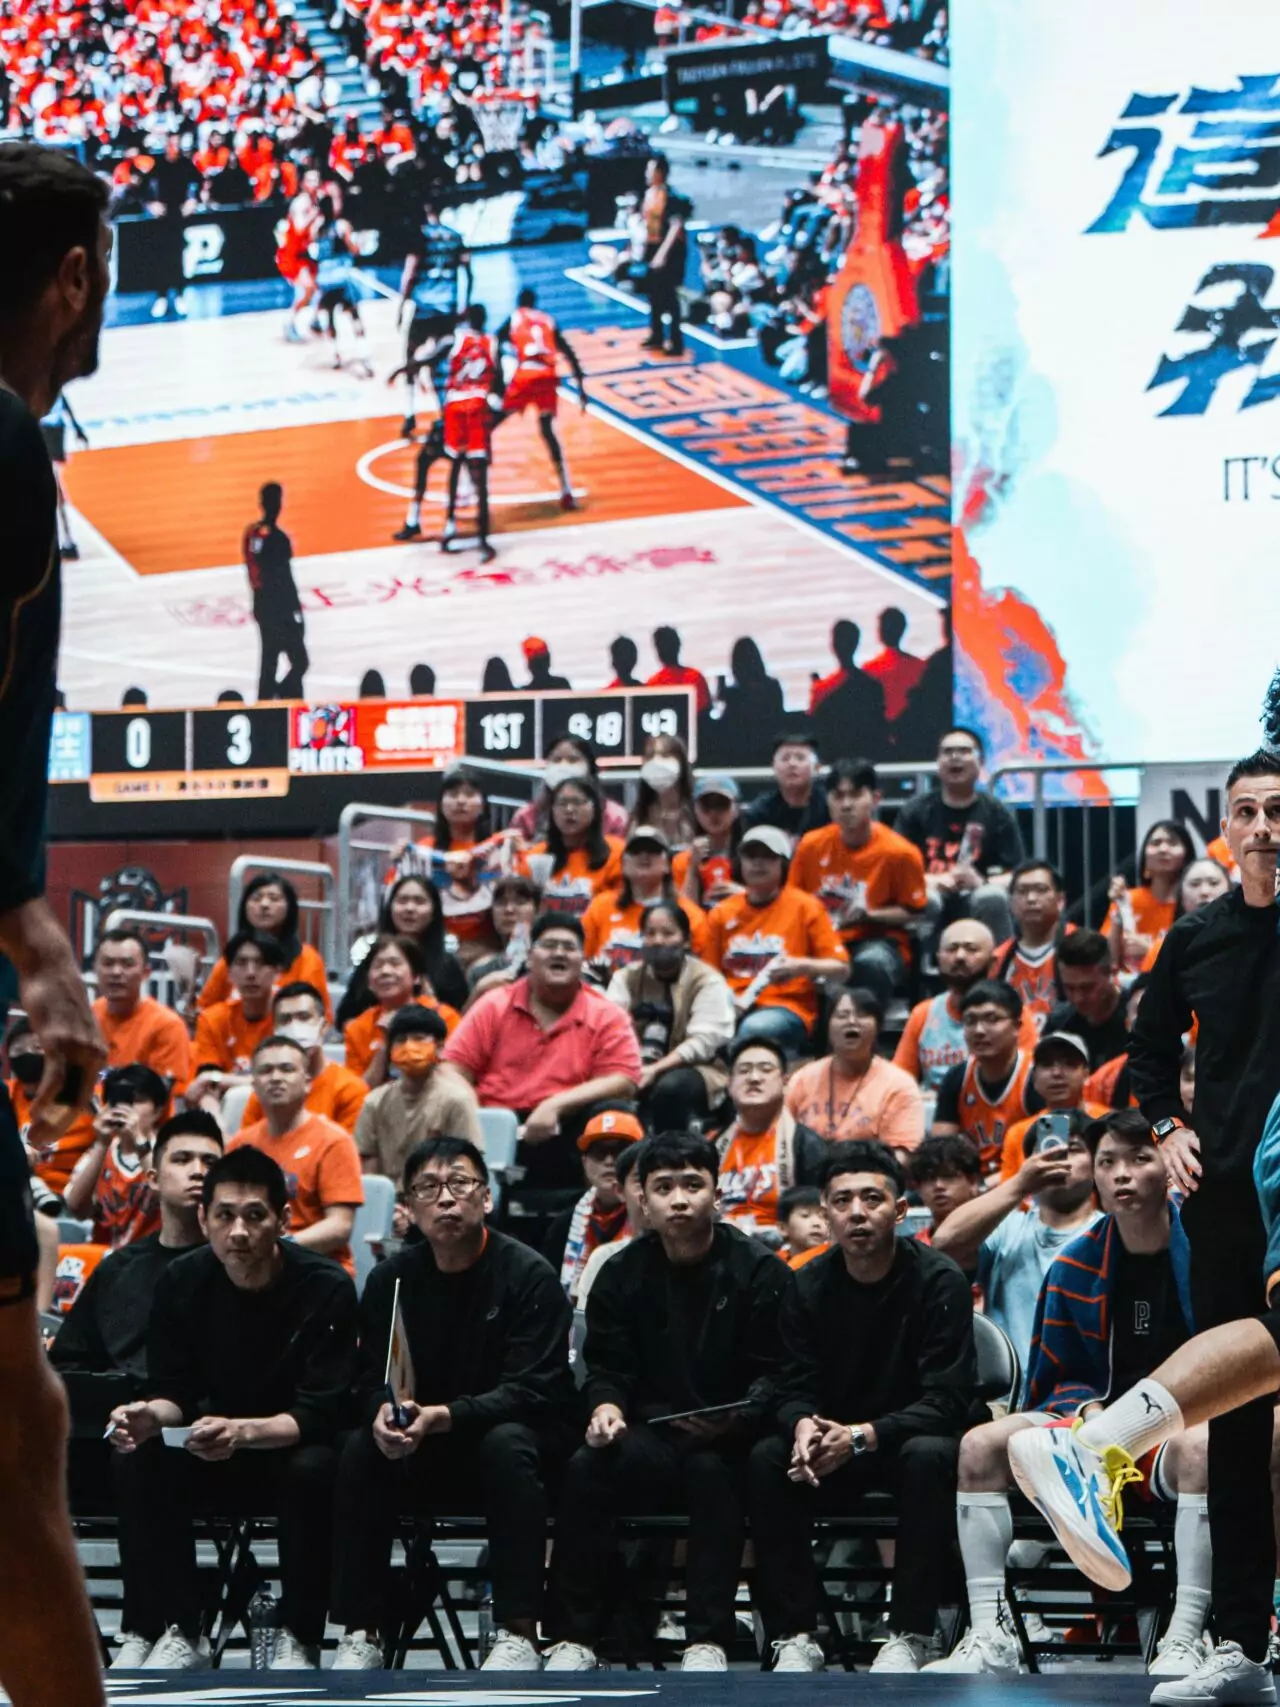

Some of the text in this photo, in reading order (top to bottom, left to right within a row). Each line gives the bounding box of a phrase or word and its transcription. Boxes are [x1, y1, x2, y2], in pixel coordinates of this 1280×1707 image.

[126, 717, 152, 769] 0
[226, 714, 252, 765] 3
[479, 712, 525, 750] 1ST
